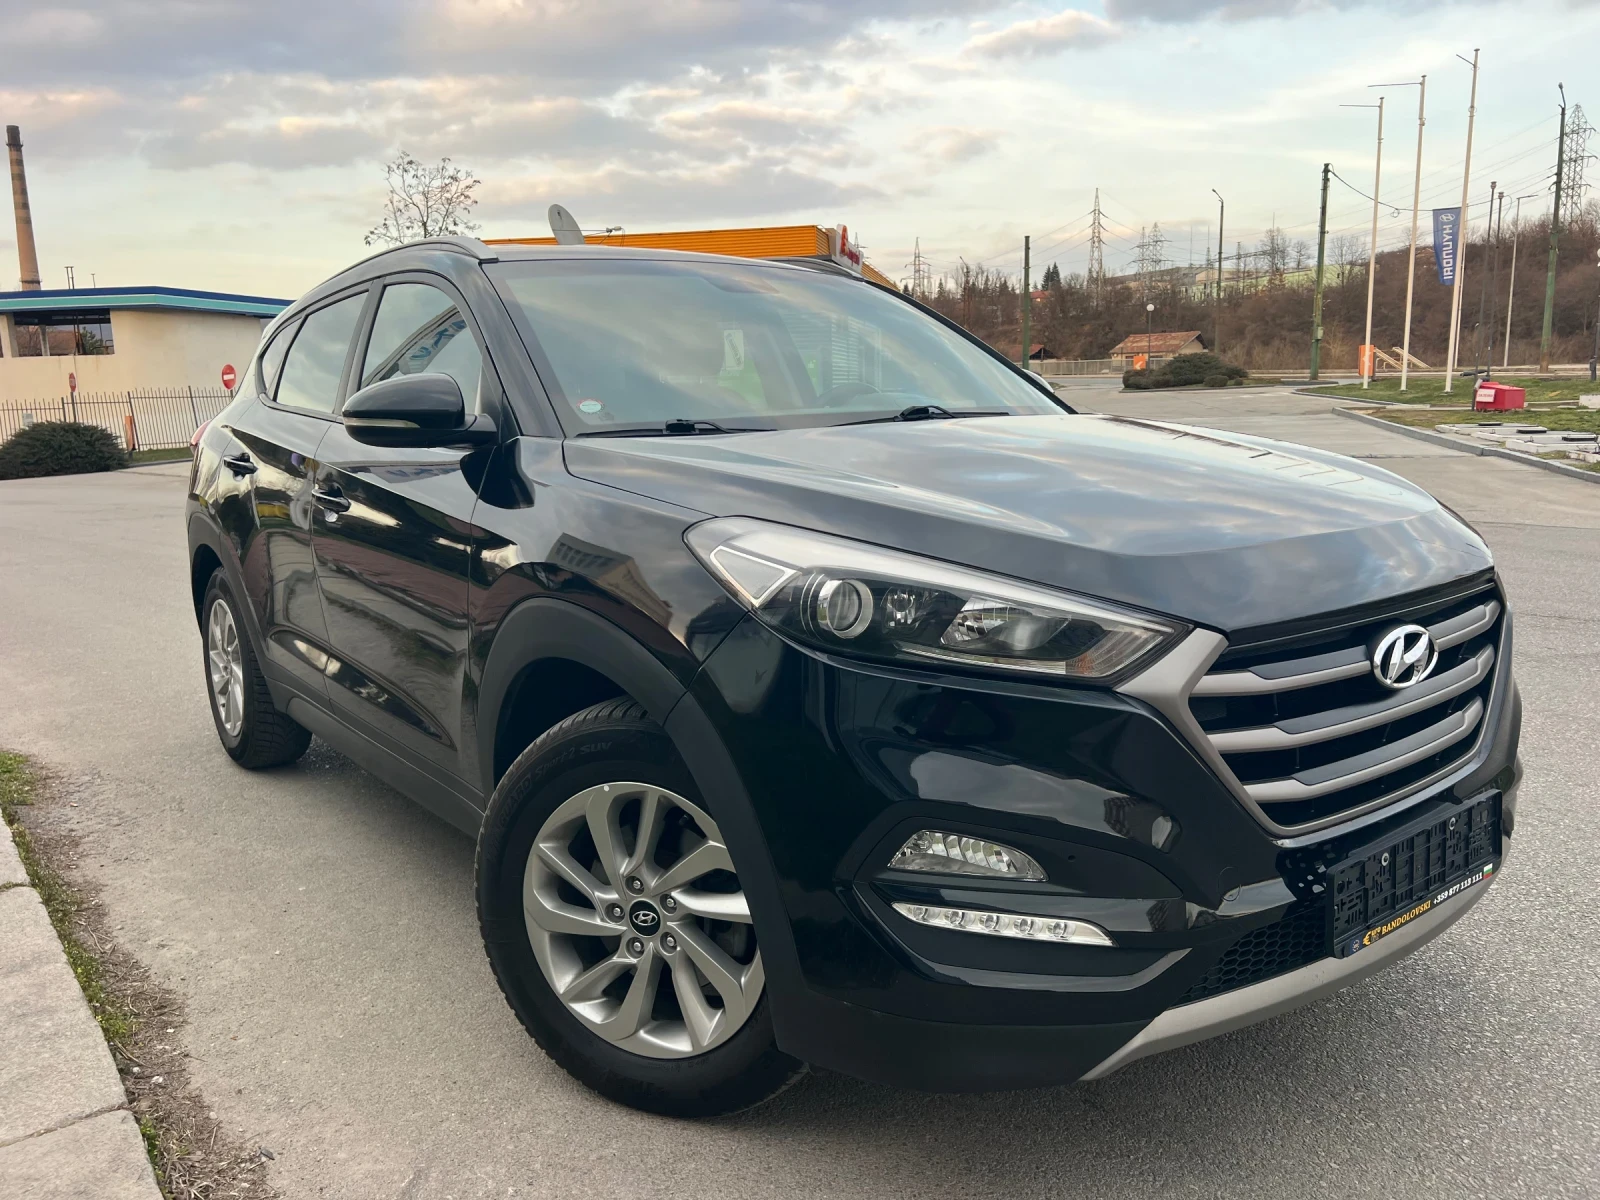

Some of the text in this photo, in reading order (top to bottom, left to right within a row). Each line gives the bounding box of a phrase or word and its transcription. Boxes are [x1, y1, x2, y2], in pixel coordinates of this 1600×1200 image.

[580, 741, 613, 754] SUV
[1381, 900, 1431, 935] BANDOLOVSKI
[1433, 890, 1448, 905] +359
[1448, 884, 1460, 896] 877
[1472, 872, 1483, 882] 111
